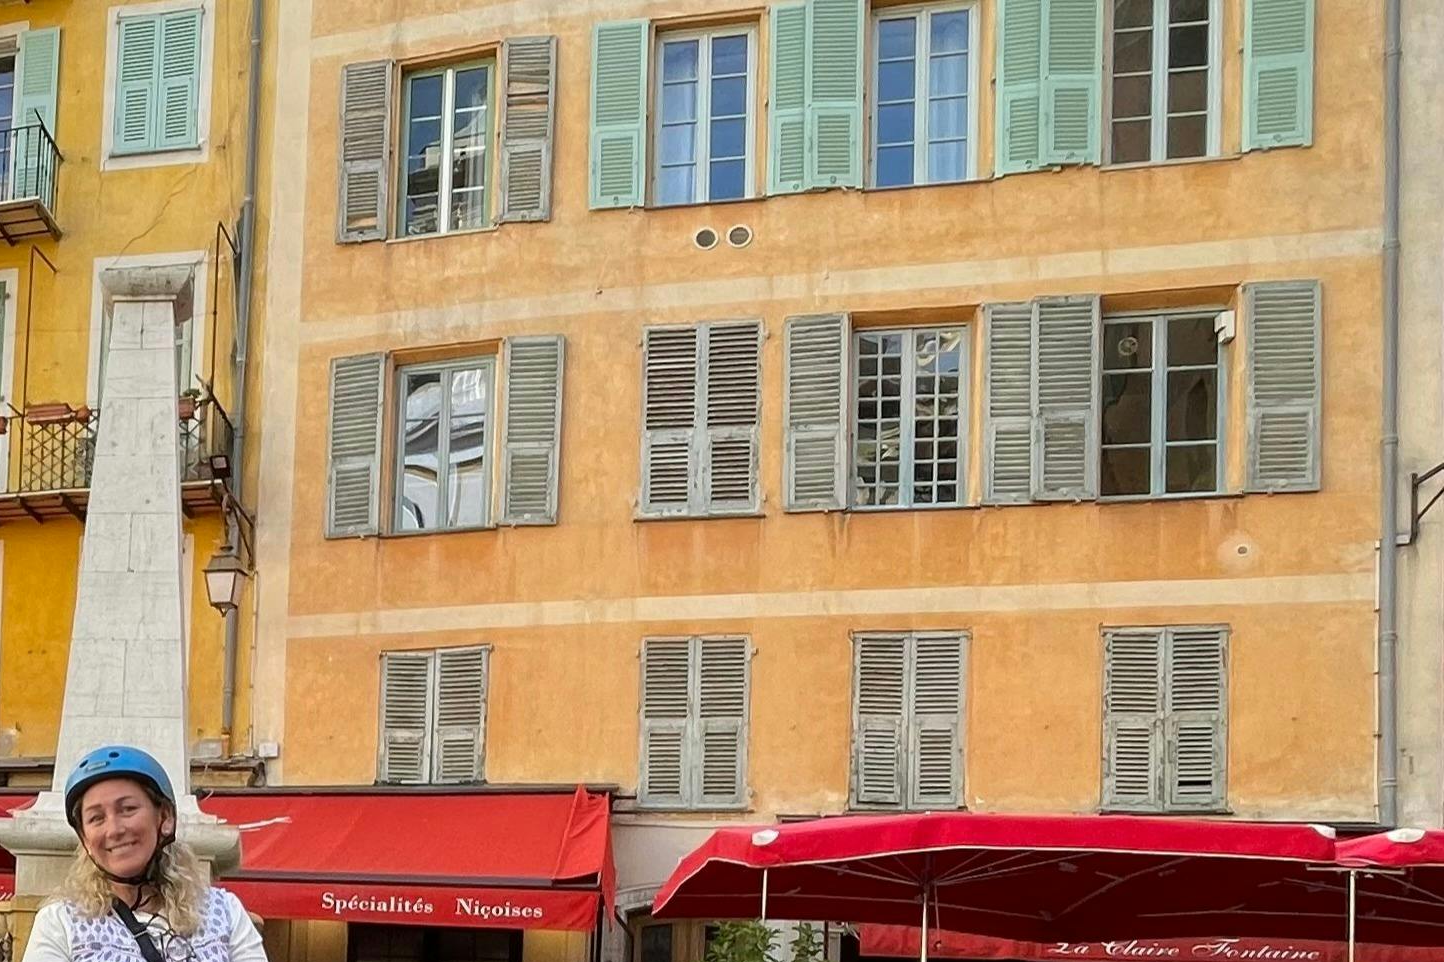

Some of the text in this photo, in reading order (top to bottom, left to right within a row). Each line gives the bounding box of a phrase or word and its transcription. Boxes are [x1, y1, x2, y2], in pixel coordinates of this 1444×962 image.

[321, 892, 544, 919] Spécialités Niçoises
[1101, 939, 1180, 957] Claire
[1192, 938, 1320, 961] Fontaine
